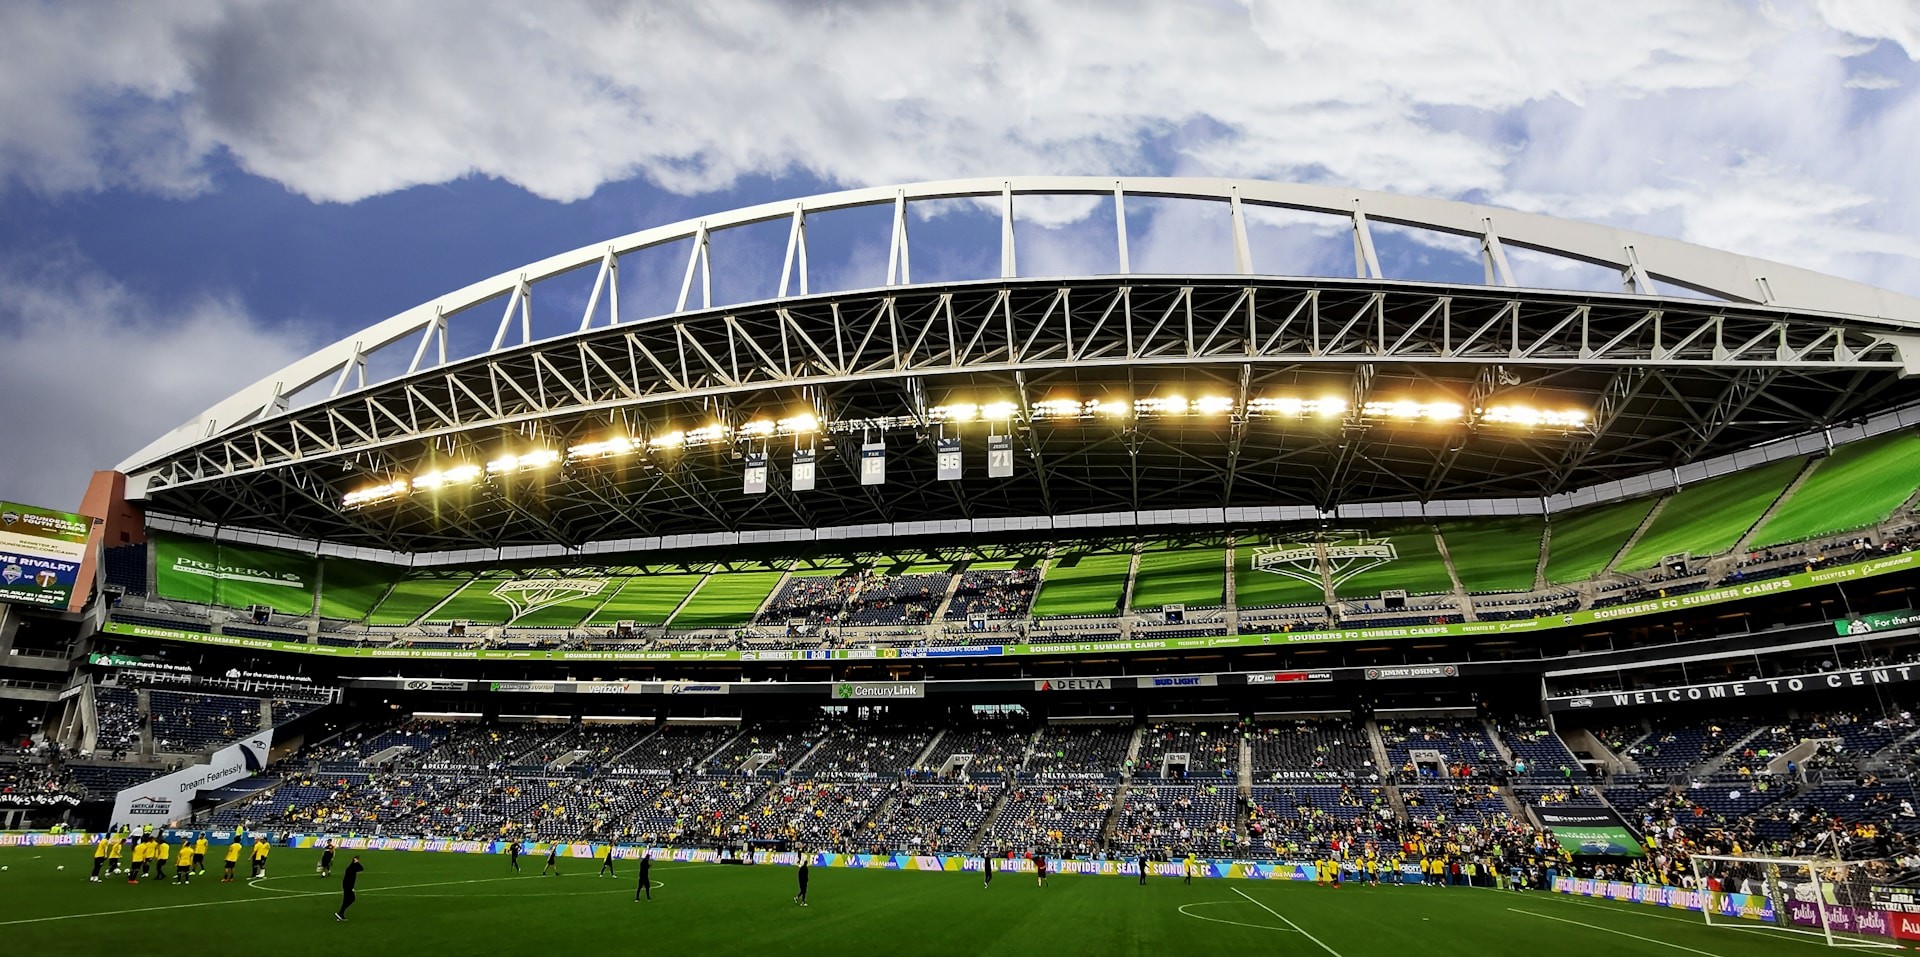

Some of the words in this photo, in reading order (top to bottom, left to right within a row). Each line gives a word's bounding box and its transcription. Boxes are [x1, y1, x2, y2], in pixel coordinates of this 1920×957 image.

[940, 454, 960, 469] 96
[992, 451, 1009, 467] 71
[795, 465, 812, 480] 80
[865, 460, 881, 474] 12
[747, 469, 765, 483] 45
[23, 514, 72, 526] SOUNDERS
[23, 518, 53, 527] YOUTH
[55, 523, 86, 533] CAMPS
[1262, 549, 1358, 565] SOUNERS
[1363, 548, 1388, 556] FC
[20, 558, 75, 571] RIVALRY
[177, 557, 272, 578] PREMERA
[1811, 570, 1847, 582] PRESENTED
[1873, 556, 1913, 569] BOEING
[1593, 602, 1659, 619] SOUNDERS
[1661, 599, 1678, 609] FC
[1682, 589, 1739, 605] SUMMER
[1743, 579, 1792, 596] CAMPS
[1875, 618, 1890, 628] For
[1892, 616, 1908, 626] the
[134, 627, 185, 639] SOUNDERS
[202, 635, 241, 645] SUMMER
[243, 639, 273, 648] CAMPS
[1288, 632, 1342, 642] SOUNDERS
[1345, 631, 1358, 639] FC
[1361, 628, 1407, 638] SUMMER
[1409, 627, 1448, 636] CAMPS
[1030, 645, 1077, 653] SOUNDERS
[1135, 641, 1166, 649] CAMPS
[1248, 674, 1264, 682] 710
[1381, 669, 1409, 678] JIMMY
[1410, 667, 1441, 676] JOHN'S
[588, 683, 625, 694] verizon
[1058, 679, 1104, 689] DELTA
[1155, 678, 1174, 686] BUD
[1174, 677, 1199, 685] LIGHT
[1613, 684, 1746, 706] WELCOME
[1766, 678, 1804, 693] TO
[1826, 667, 1911, 688] CENT
[855, 685, 917, 696] CenturyLink
[180, 777, 205, 793] Dream
[207, 763, 243, 782] Fearlessly
[0, 834, 31, 845] SEATTLE
[33, 834, 73, 845] SOUNDERS
[75, 834, 84, 844] FC
[314, 839, 340, 847] OFFIAL
[340, 839, 366, 848] MEDICAL
[367, 839, 384, 848] CARE
[384, 840, 413, 849] PROVIDER
[423, 841, 447, 850] SEATTLE
[449, 842, 481, 851] SOUNDERS
[482, 843, 491, 851] FC
[611, 848, 640, 859] OFFICIAL
[673, 849, 691, 860] CARE
[809, 854, 819, 865] FC
[1001, 860, 1035, 871] MEDICAL
[1061, 861, 1100, 873] PROVIDER
[1104, 863, 1113, 873] OF
[1201, 865, 1212, 875] FC
[1260, 870, 1283, 878] Virginia
[1284, 870, 1305, 878] Mason
[1556, 878, 1574, 892] OFFICIAL
[1575, 880, 1594, 894] MEDICAL
[1594, 881, 1607, 895] CARE
[1607, 883, 1633, 899] PROVIDER
[1634, 885, 1641, 900] OF
[1643, 887, 1667, 904] SEATTLE
[1668, 889, 1702, 908] SOUNDERS
[1754, 905, 1773, 917] Mason
